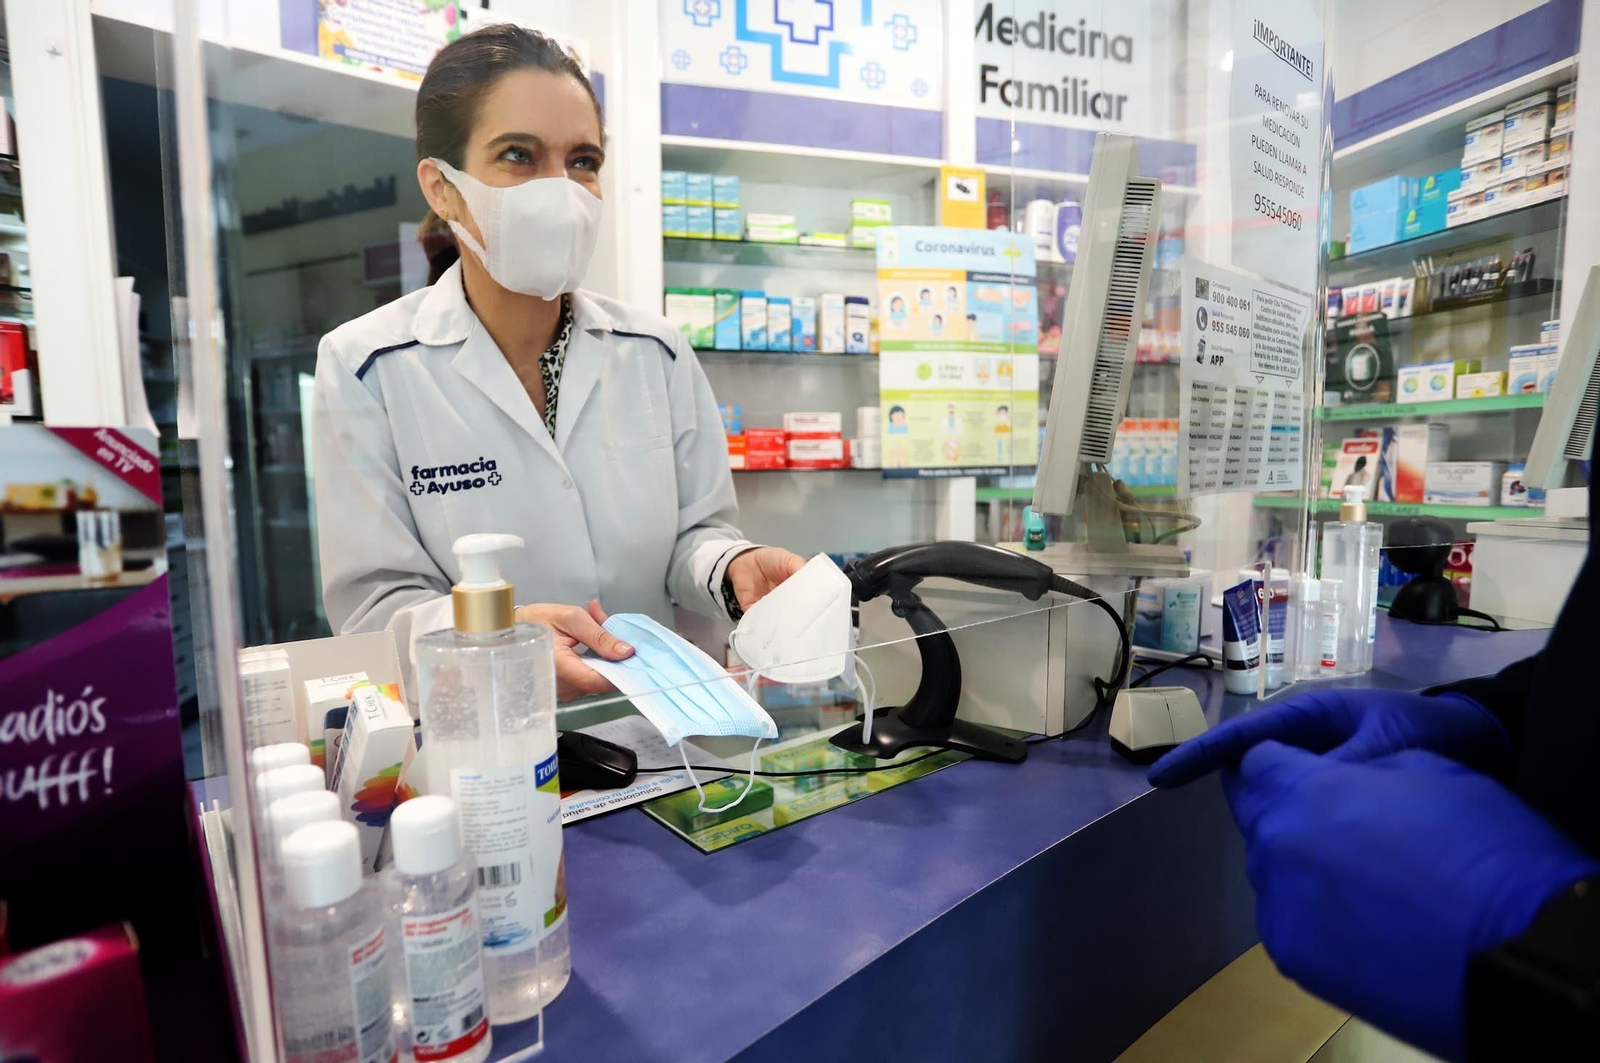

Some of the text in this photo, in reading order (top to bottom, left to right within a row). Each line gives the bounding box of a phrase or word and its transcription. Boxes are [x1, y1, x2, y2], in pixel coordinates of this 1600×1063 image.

[1253, 18, 1314, 79] ¡IMPORTANTE!
[980, 63, 1128, 121] Familiar
[1254, 83, 1309, 129] PARA RENOVAR SU
[1262, 115, 1300, 148] MEDICACIÓN
[1251, 134, 1307, 176] PUEDEN LLAMAR A
[1253, 161, 1305, 198] SALUD RESPONDE
[1254, 193, 1302, 231] 955545060
[915, 240, 996, 256] Coronavirus
[1212, 291, 1251, 311] 900 400 061
[1211, 320, 1250, 338] 955 545 060
[1210, 354, 1225, 366] APP
[411, 456, 497, 480] farmacia
[427, 477, 486, 495] Ayuso
[0, 685, 108, 746] adiós
[0, 746, 115, 810] ufff!
[568, 794, 611, 811] consulta
[593, 801, 607, 811] de
[607, 785, 663, 805] Soluciones
[562, 805, 592, 819] salud
